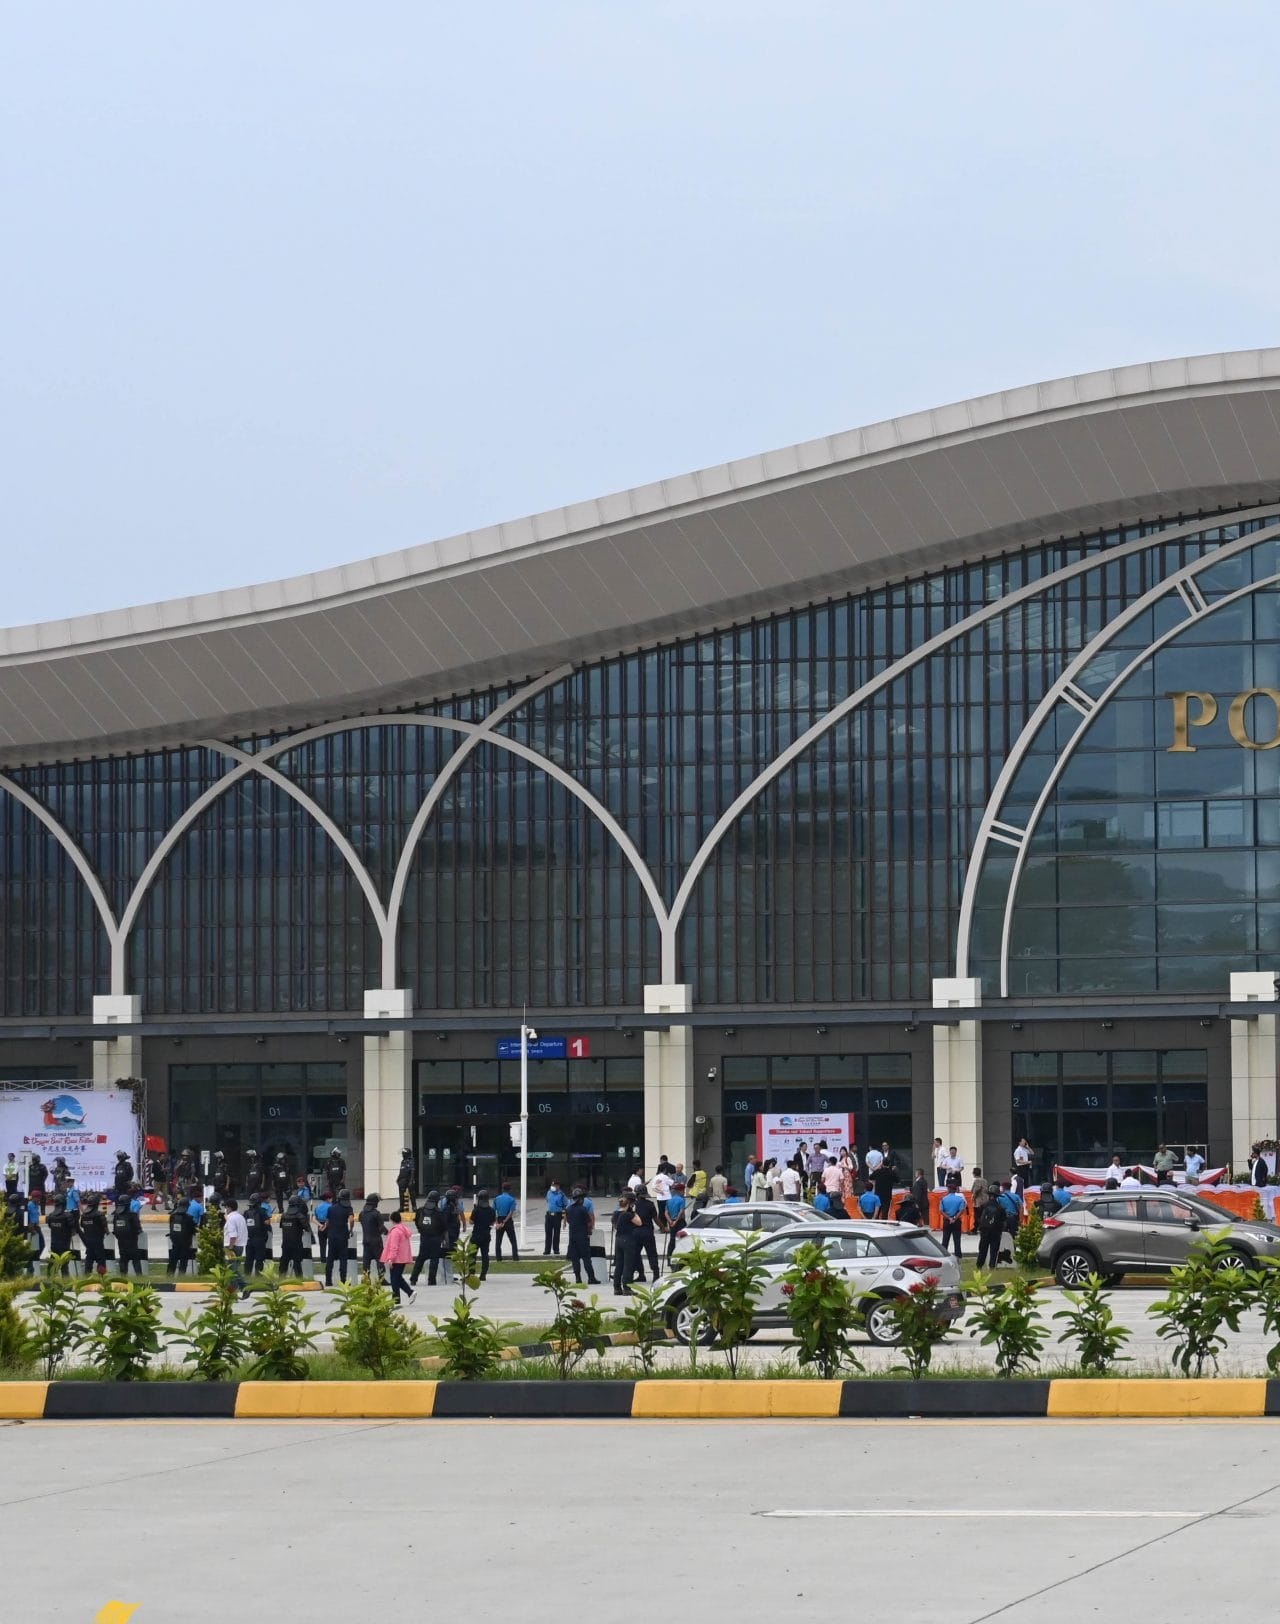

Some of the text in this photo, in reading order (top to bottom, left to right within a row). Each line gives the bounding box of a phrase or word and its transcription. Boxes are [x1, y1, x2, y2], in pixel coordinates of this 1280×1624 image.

[572, 1039, 583, 1057] 1
[734, 1101, 749, 1111] 08
[875, 1100, 888, 1109] 10
[1085, 1096, 1099, 1107] 13
[268, 1106, 281, 1117] 01
[464, 1104, 478, 1114] 04
[538, 1103, 552, 1113] 05
